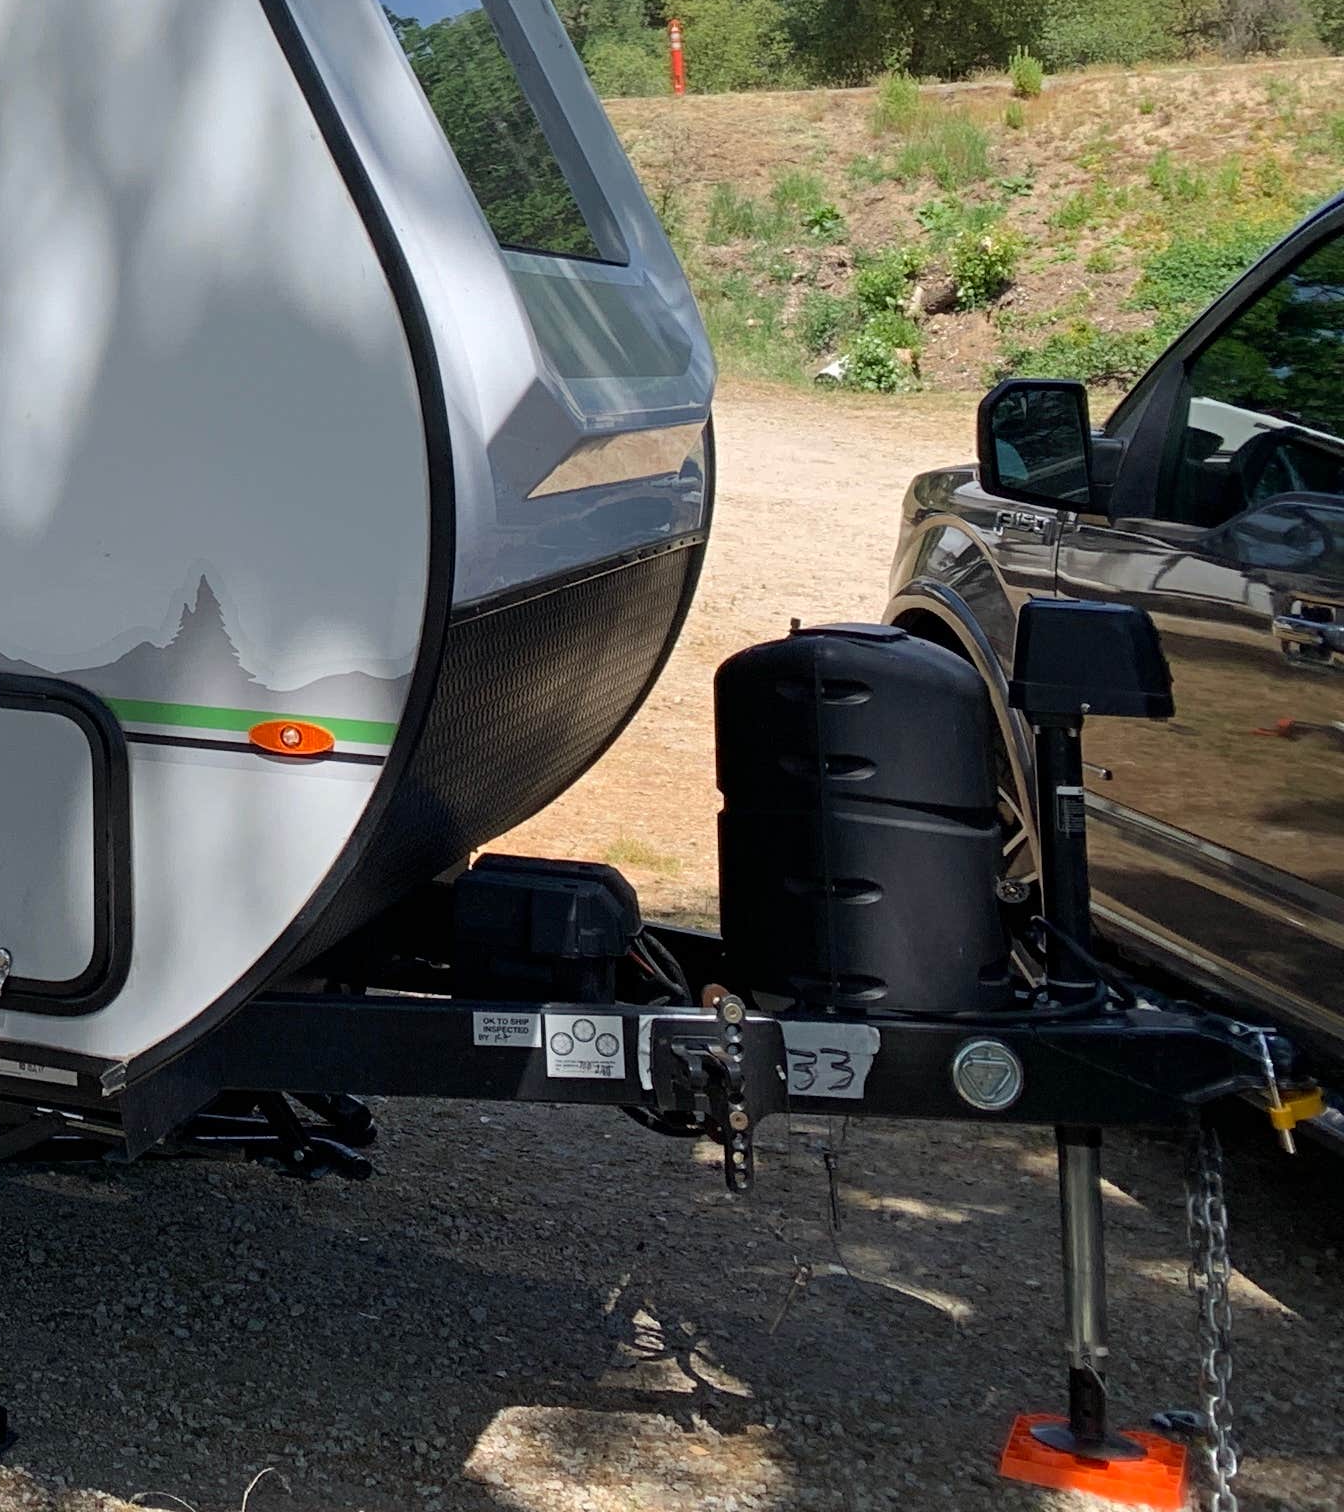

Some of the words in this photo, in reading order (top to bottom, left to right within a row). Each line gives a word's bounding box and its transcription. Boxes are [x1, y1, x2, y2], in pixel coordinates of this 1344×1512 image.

[483, 1017, 495, 1025] OK
[510, 1018, 529, 1026] SHIP
[483, 1026, 529, 1034] INSPECTED
